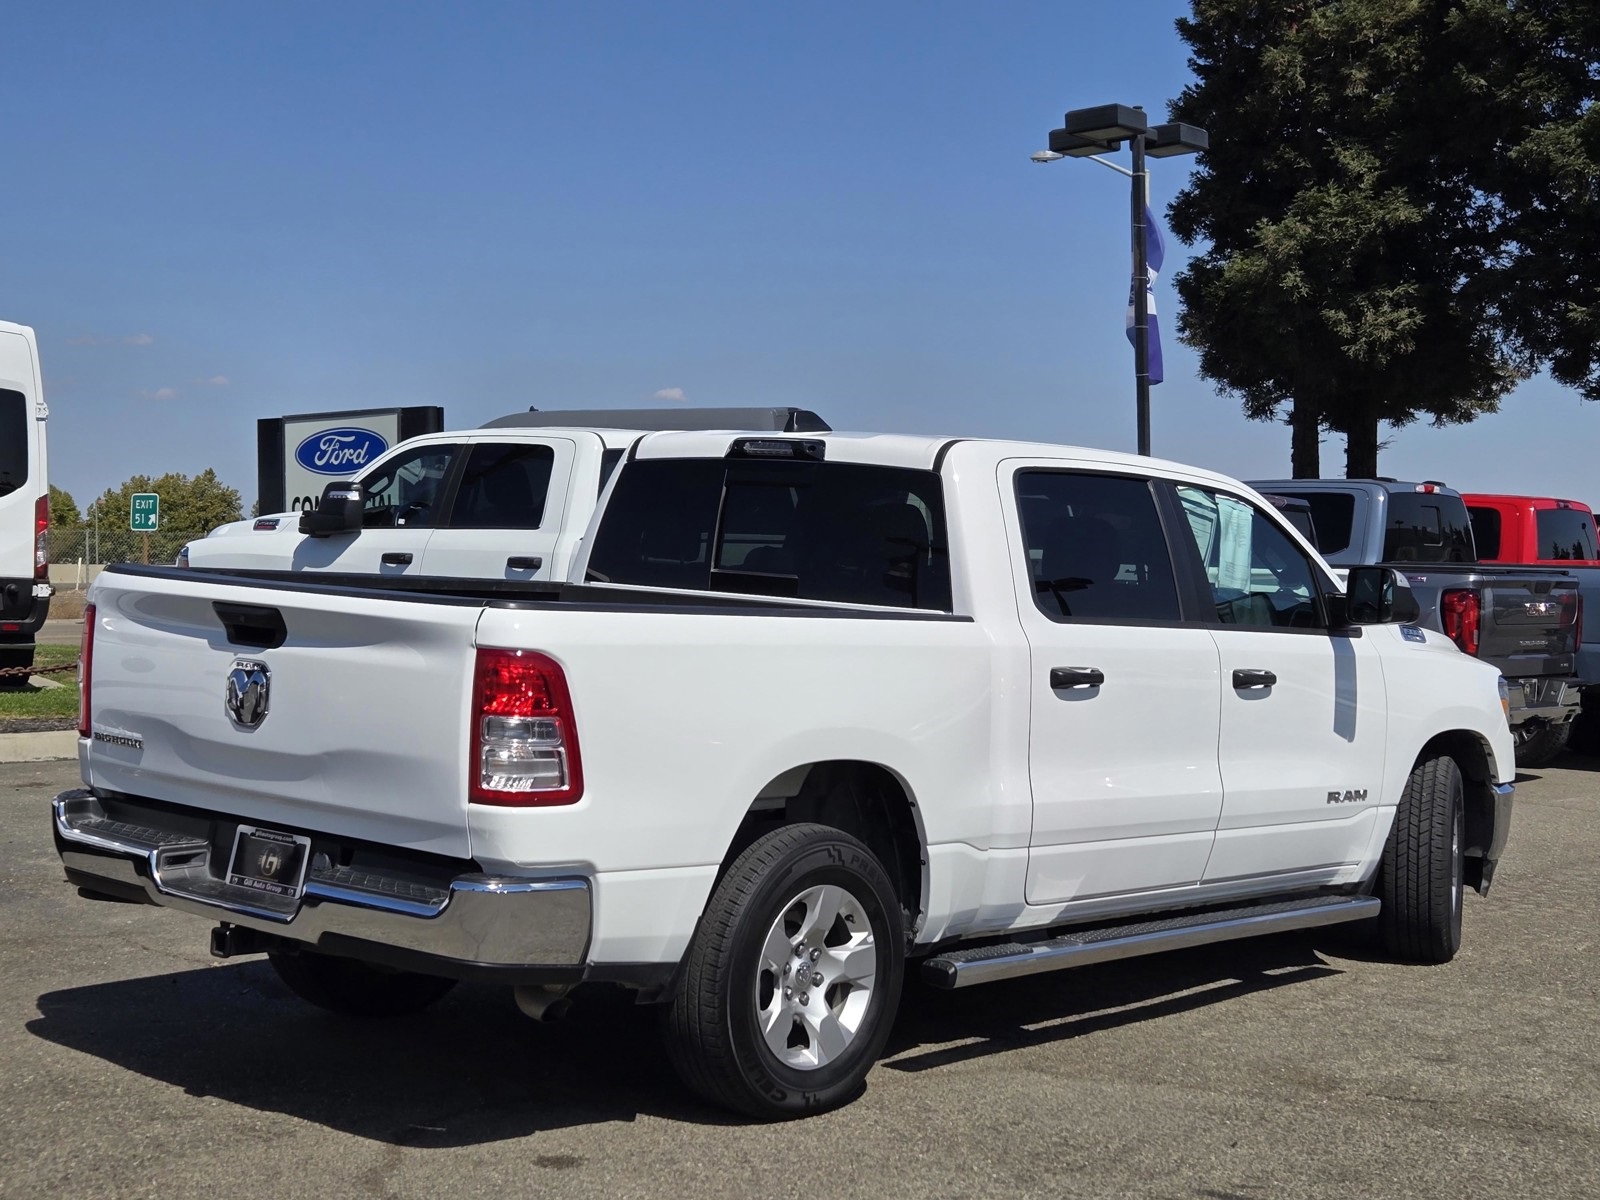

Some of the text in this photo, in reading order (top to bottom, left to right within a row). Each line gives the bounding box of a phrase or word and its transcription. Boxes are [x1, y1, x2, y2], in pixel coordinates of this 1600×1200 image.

[314, 435, 370, 466] Ford
[135, 499, 154, 509] EXIT
[135, 513, 145, 524] 51
[1326, 789, 1368, 804] RAM
[253, 880, 266, 889] Auto
[266, 883, 283, 894] Group
